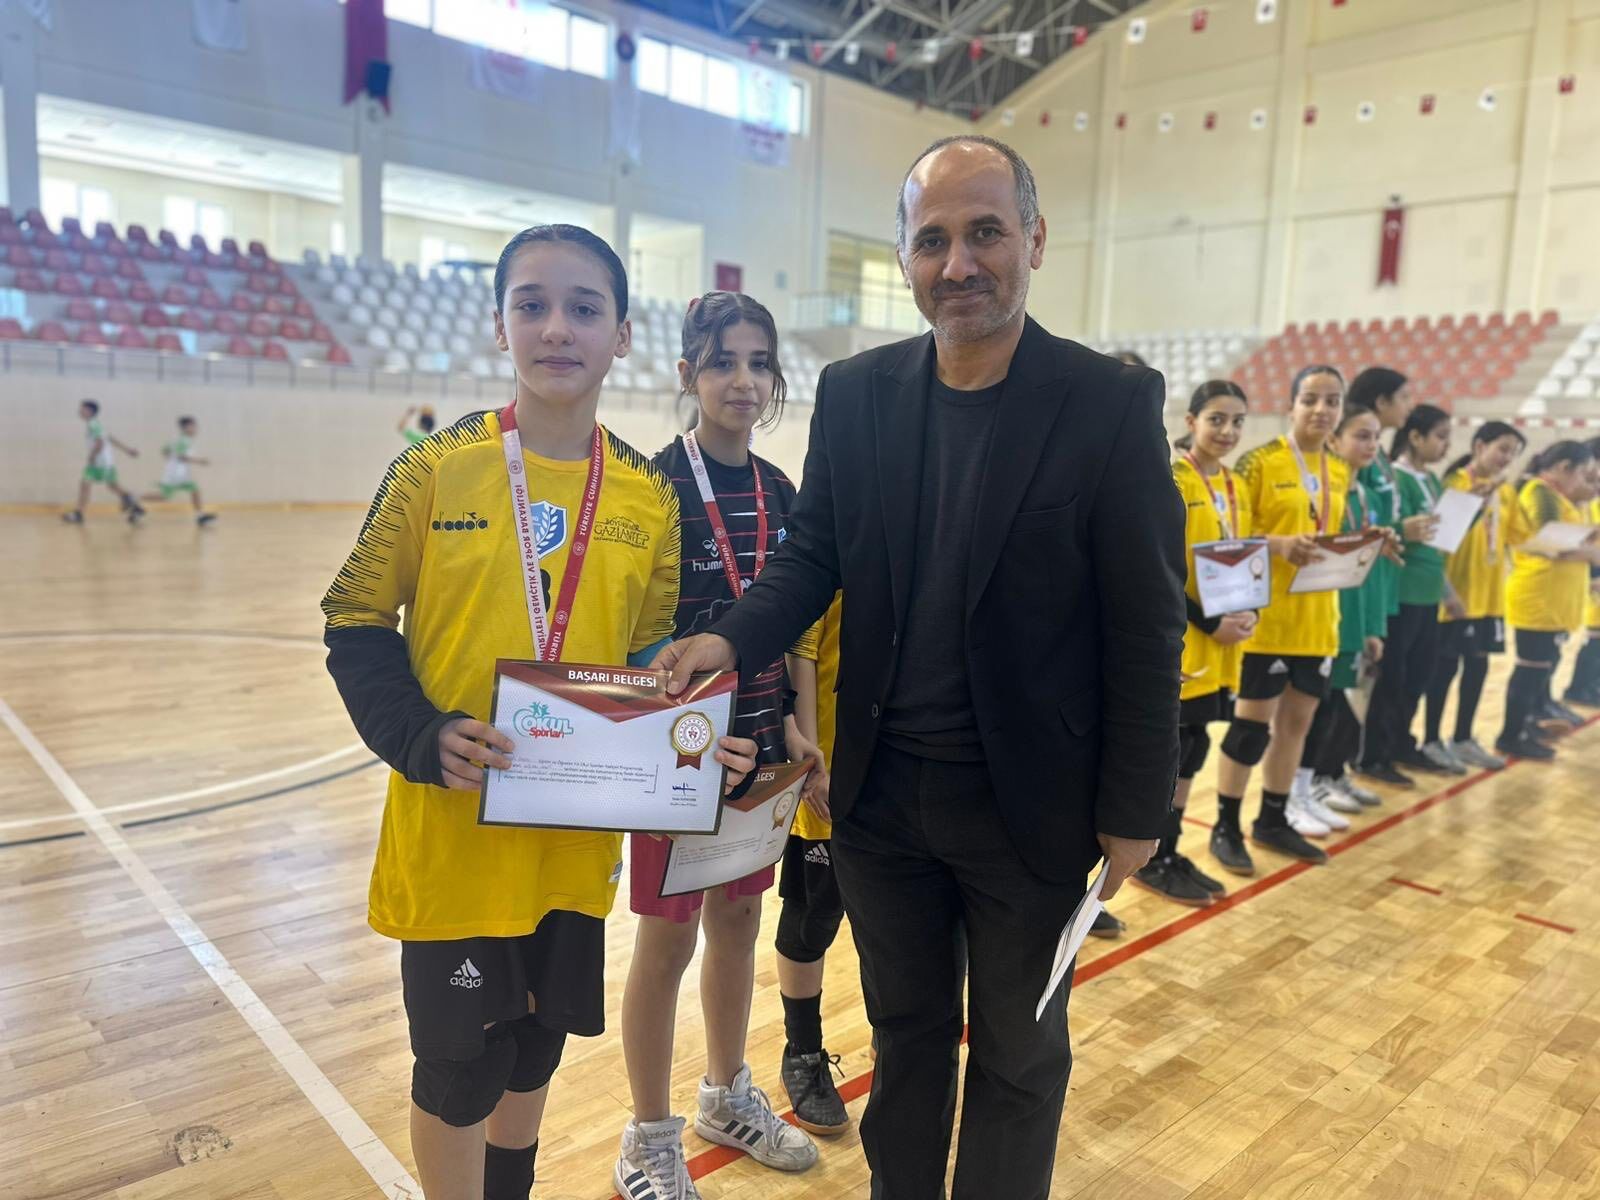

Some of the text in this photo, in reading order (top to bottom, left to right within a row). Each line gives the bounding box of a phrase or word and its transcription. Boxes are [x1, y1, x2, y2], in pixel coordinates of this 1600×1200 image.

[432, 511, 488, 531] diadora
[579, 501, 593, 536] TÜRKİYE
[568, 670, 656, 688] BAŞARI BELGESİ
